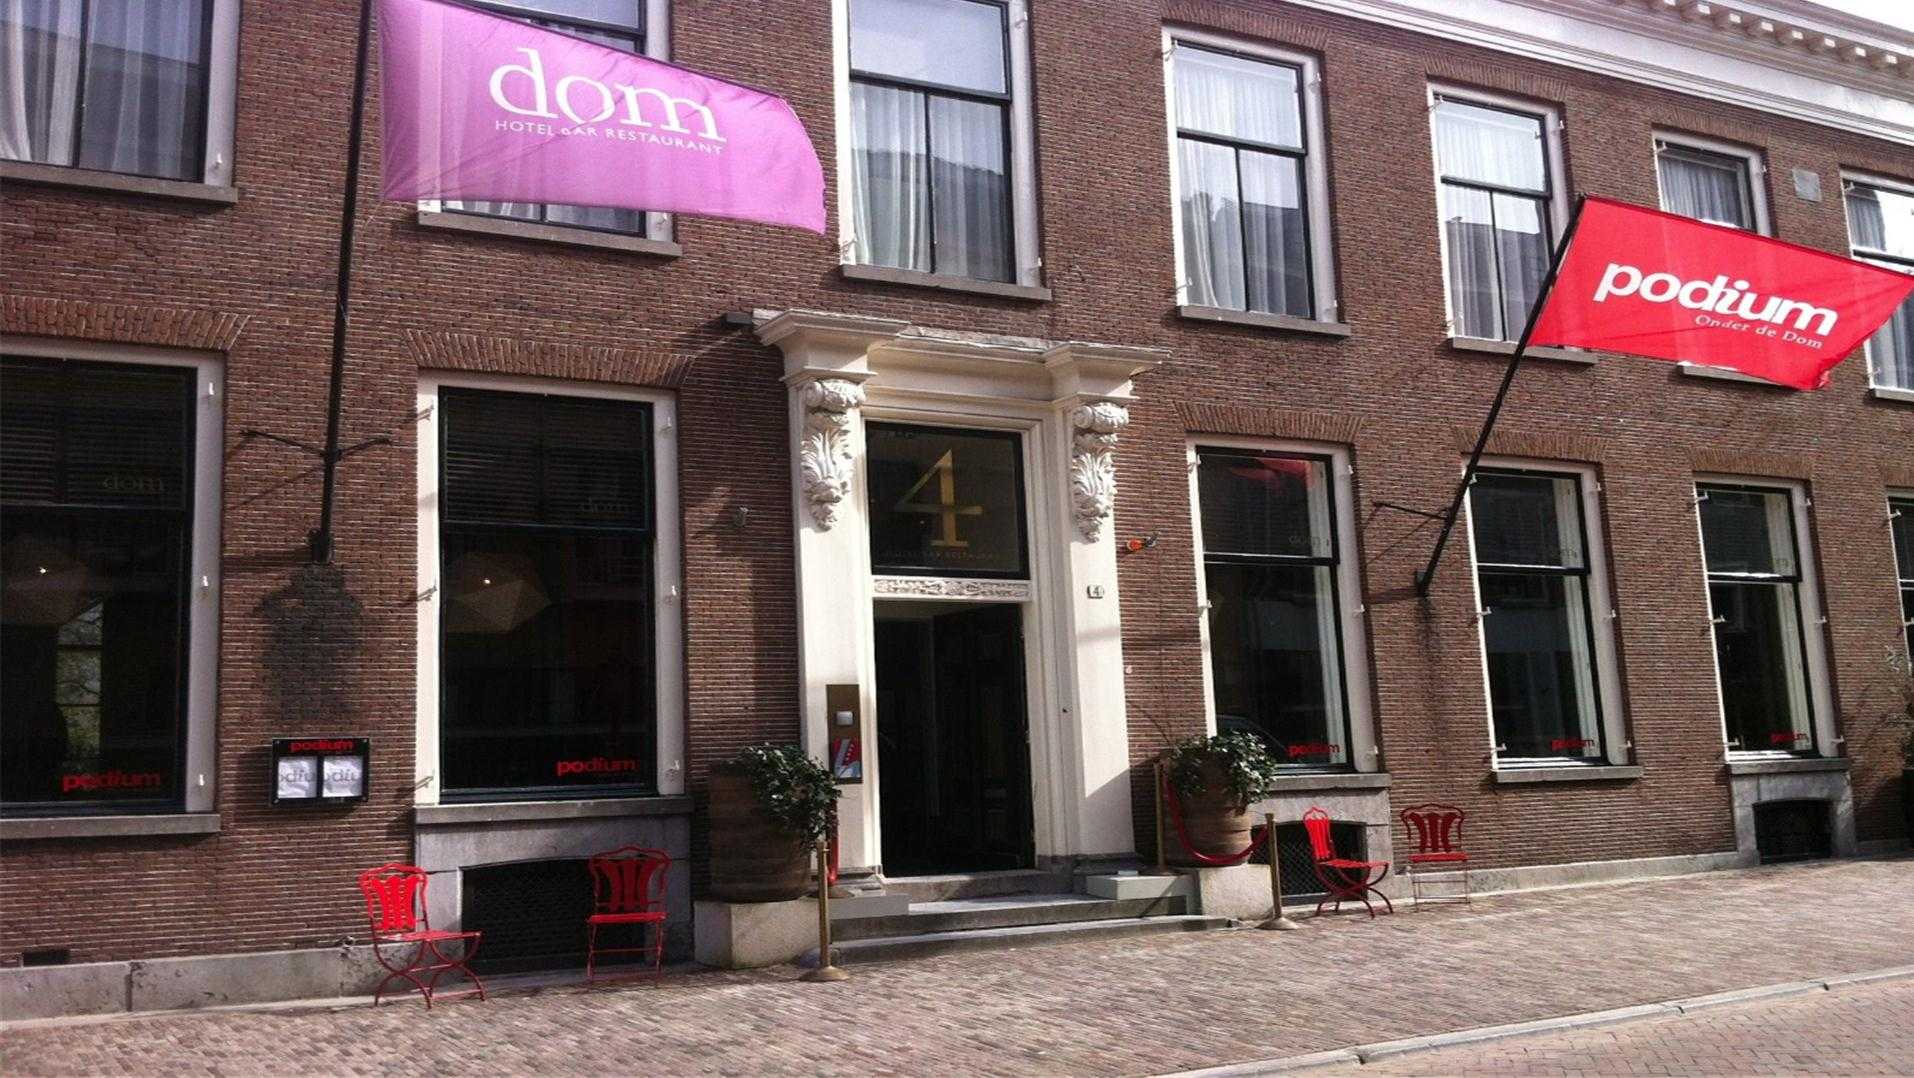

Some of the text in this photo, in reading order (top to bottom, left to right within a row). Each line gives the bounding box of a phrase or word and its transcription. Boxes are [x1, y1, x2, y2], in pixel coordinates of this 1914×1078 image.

[489, 47, 727, 142] dom
[495, 120, 555, 138] HOTEL
[606, 128, 724, 154] RESTAURANT
[1593, 263, 1839, 336] podium
[1695, 314, 1822, 350] Onder de Dom
[894, 448, 983, 547] 4
[63, 768, 162, 792] podium
[557, 757, 637, 777] podium
